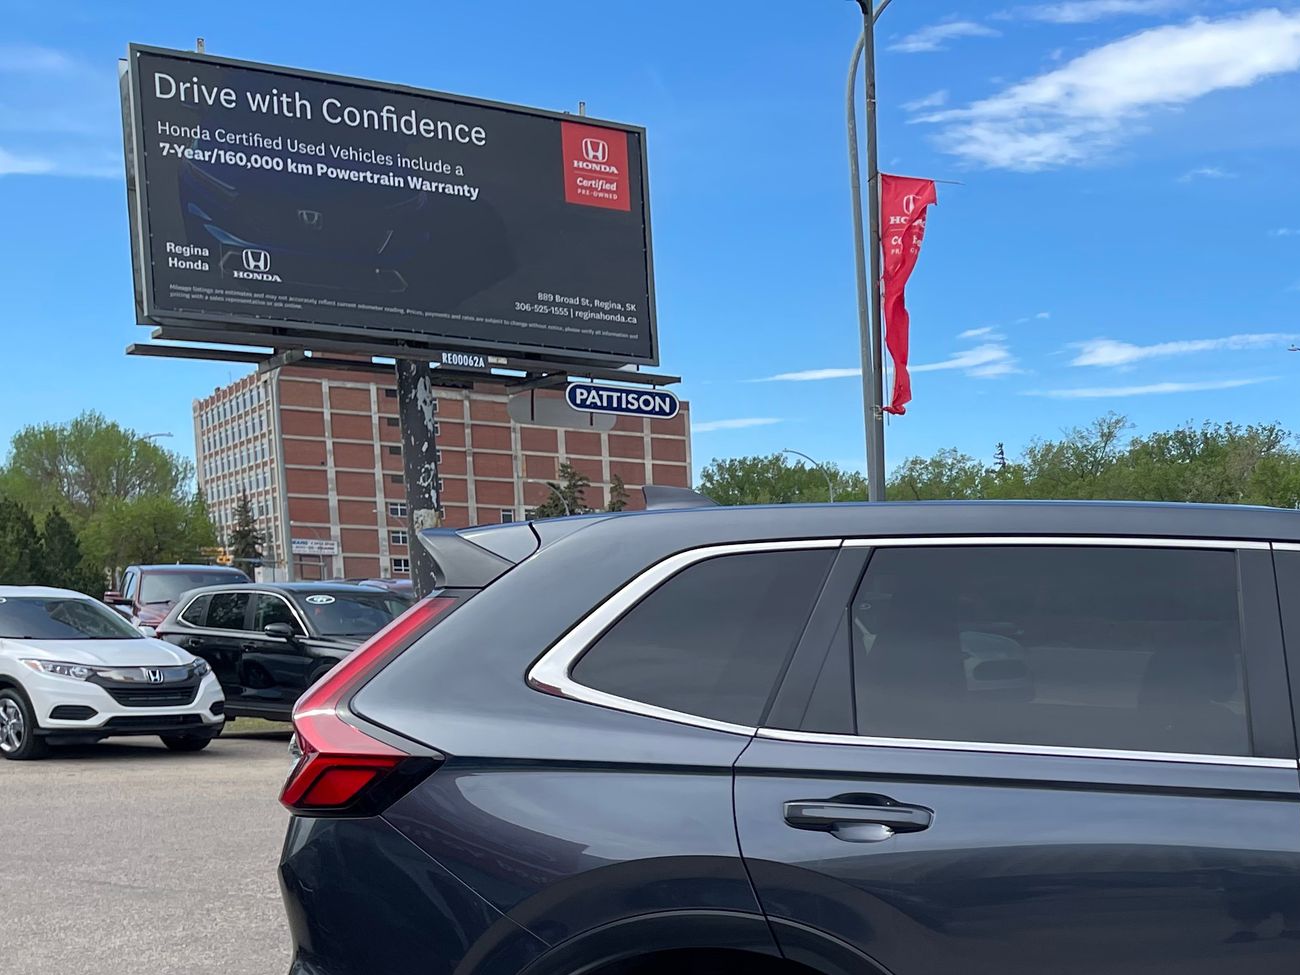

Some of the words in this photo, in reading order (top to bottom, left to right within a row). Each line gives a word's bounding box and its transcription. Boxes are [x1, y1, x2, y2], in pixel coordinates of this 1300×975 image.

[154, 72, 237, 108] Drive
[246, 88, 312, 120] with
[322, 98, 486, 146] Confidence
[157, 120, 210, 141] Honda
[215, 128, 282, 150] Certified
[287, 138, 325, 157] Used
[330, 144, 393, 166] Vehicles
[397, 154, 451, 174] include
[455, 165, 464, 176] a
[159, 142, 283, 170] 7-Year/160,000
[287, 158, 313, 175] km
[316, 163, 404, 188] Powertrain
[407, 175, 479, 200] Warranty
[573, 160, 618, 174] HONDA
[576, 177, 617, 191] Certified
[166, 242, 209, 257] Regina
[168, 257, 209, 271] Honda
[233, 270, 282, 282] HONDA
[537, 292, 554, 302] 889
[555, 294, 579, 305] Broad
[594, 299, 625, 312] Regina,
[625, 303, 637, 312] SK
[575, 310, 637, 324] reginahonda.ca
[441, 352, 485, 368] RE00062A
[575, 387, 671, 414] PATTISON
